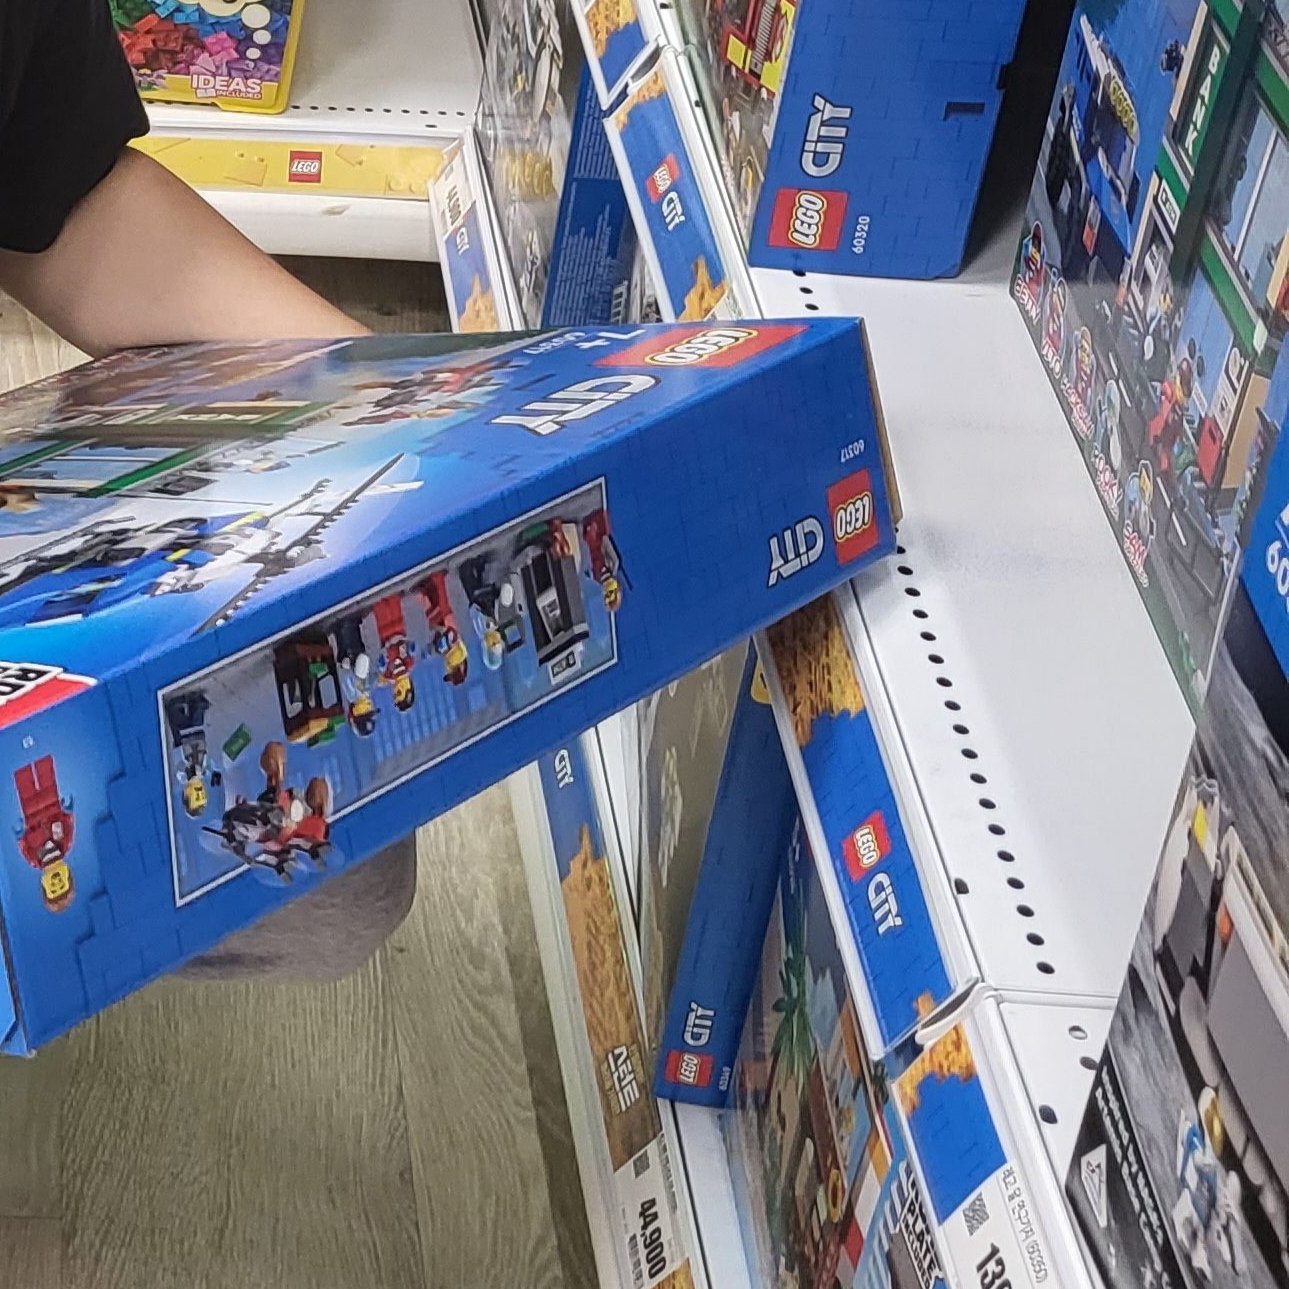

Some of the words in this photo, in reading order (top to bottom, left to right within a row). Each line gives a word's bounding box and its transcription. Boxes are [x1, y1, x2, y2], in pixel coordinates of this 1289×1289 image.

[190, 74, 262, 93] IDEAS
[215, 89, 262, 101] INCLUDED
[1184, 43, 1222, 157] BANK
[801, 93, 853, 178] CITY
[291, 159, 321, 175] LEGO
[661, 191, 686, 232] CITY
[791, 191, 827, 247] LEGO
[851, 215, 871, 255] 60320
[649, 328, 755, 366] LEGO
[489, 373, 660, 436] CITY
[840, 439, 865, 463] 60317
[833, 491, 872, 542] LEGO
[768, 516, 825, 588] CITY
[552, 748, 575, 790] CITY
[853, 824, 879, 868] LEGO
[866, 871, 904, 938] CITY
[683, 1001, 716, 1048] CITY
[679, 1052, 699, 1085] LEGO
[639, 1196, 667, 1280] 44,900
